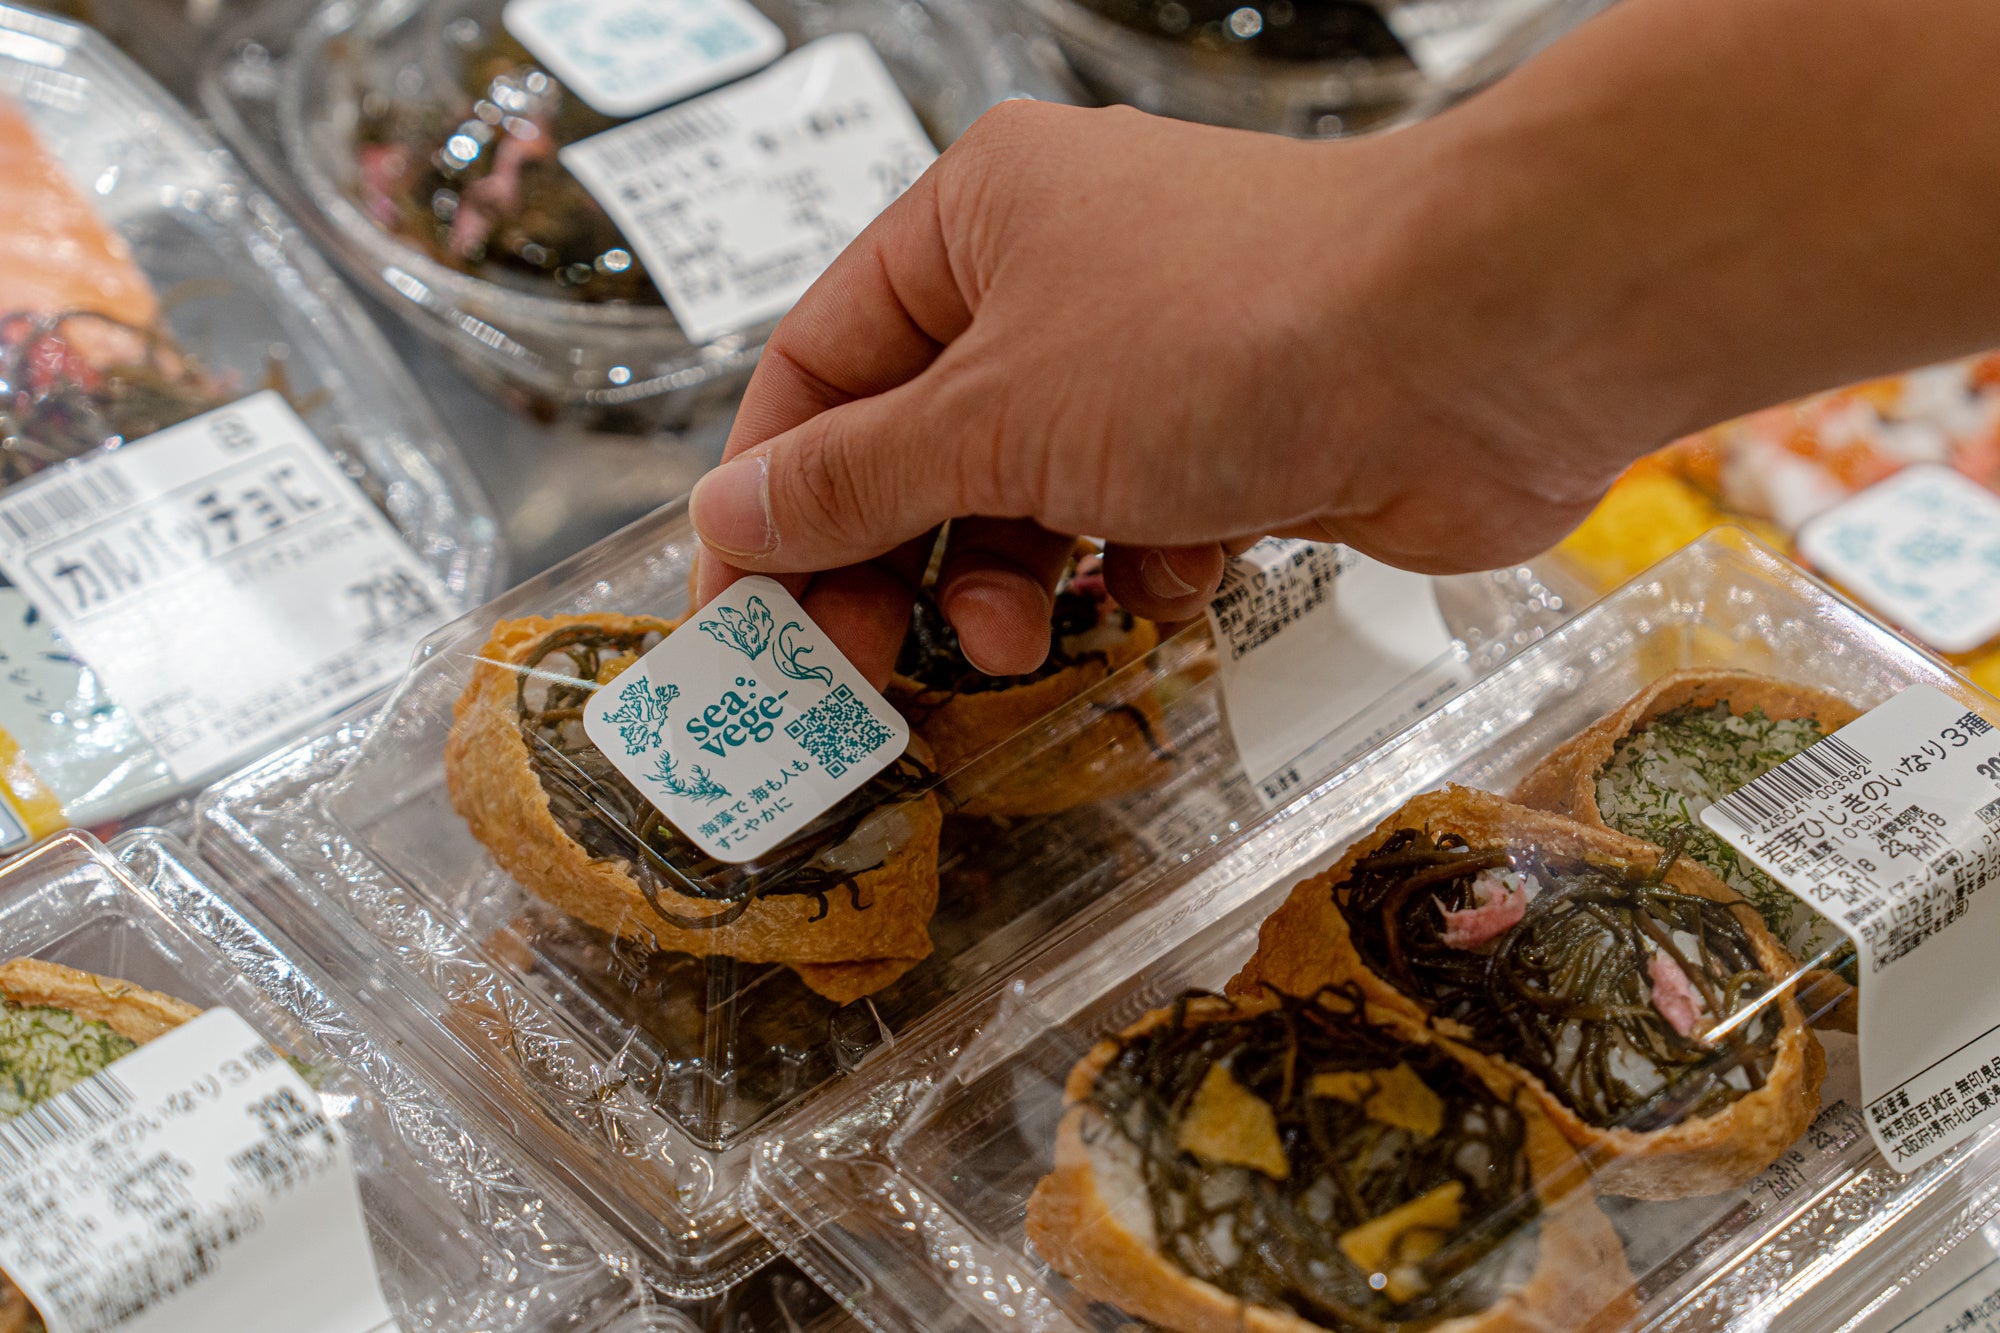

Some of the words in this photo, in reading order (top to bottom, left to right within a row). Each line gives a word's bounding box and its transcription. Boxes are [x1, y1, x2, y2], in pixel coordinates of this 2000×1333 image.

[698, 800, 749, 838] 海藻で
[747, 759, 809, 803] 海も人も
[1760, 800, 1811, 835] 445041
[1816, 764, 1871, 800] 003982
[715, 797, 793, 850] すこやかに
[1805, 854, 1848, 882] 加工日
[1907, 831, 1951, 862] PM11
[1871, 1088, 1910, 1123] 製造者
